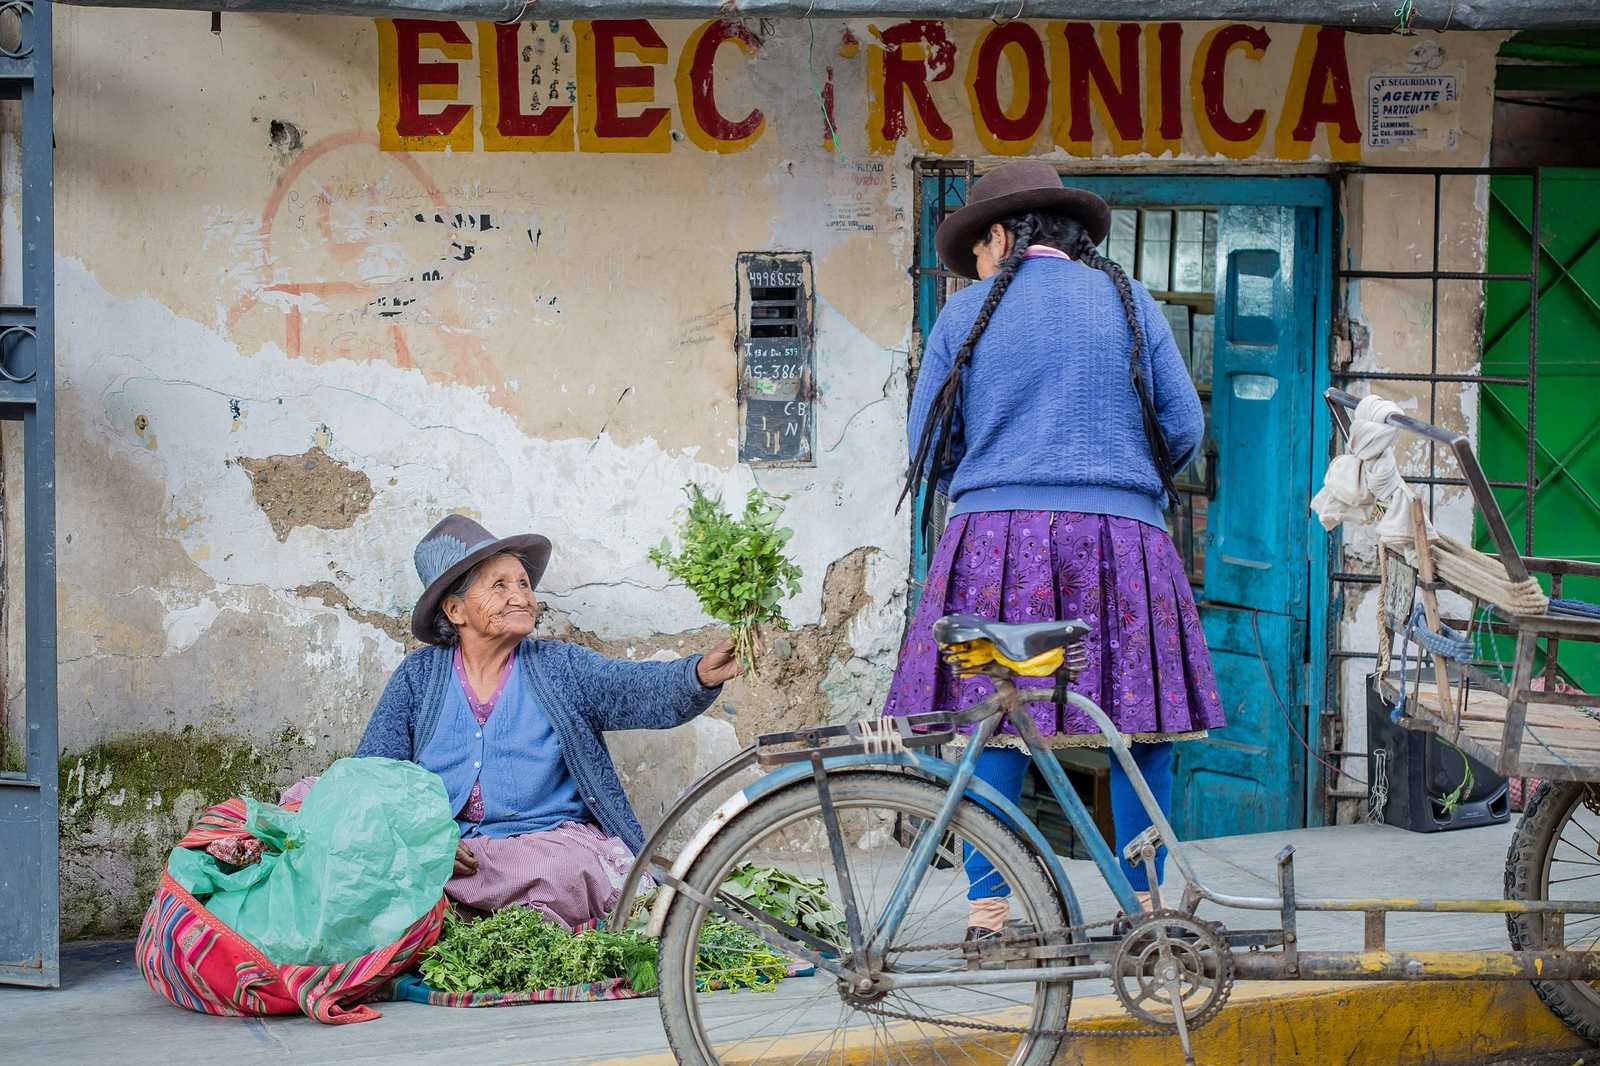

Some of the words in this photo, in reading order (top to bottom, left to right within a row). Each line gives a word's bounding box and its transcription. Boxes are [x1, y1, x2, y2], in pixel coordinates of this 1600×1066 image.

[1388, 78, 1437, 87] SEGURIDAD
[376, 18, 1361, 161] ELECRONICA
[1382, 91, 1441, 101] AGENTE
[785, 422, 799, 437] N
